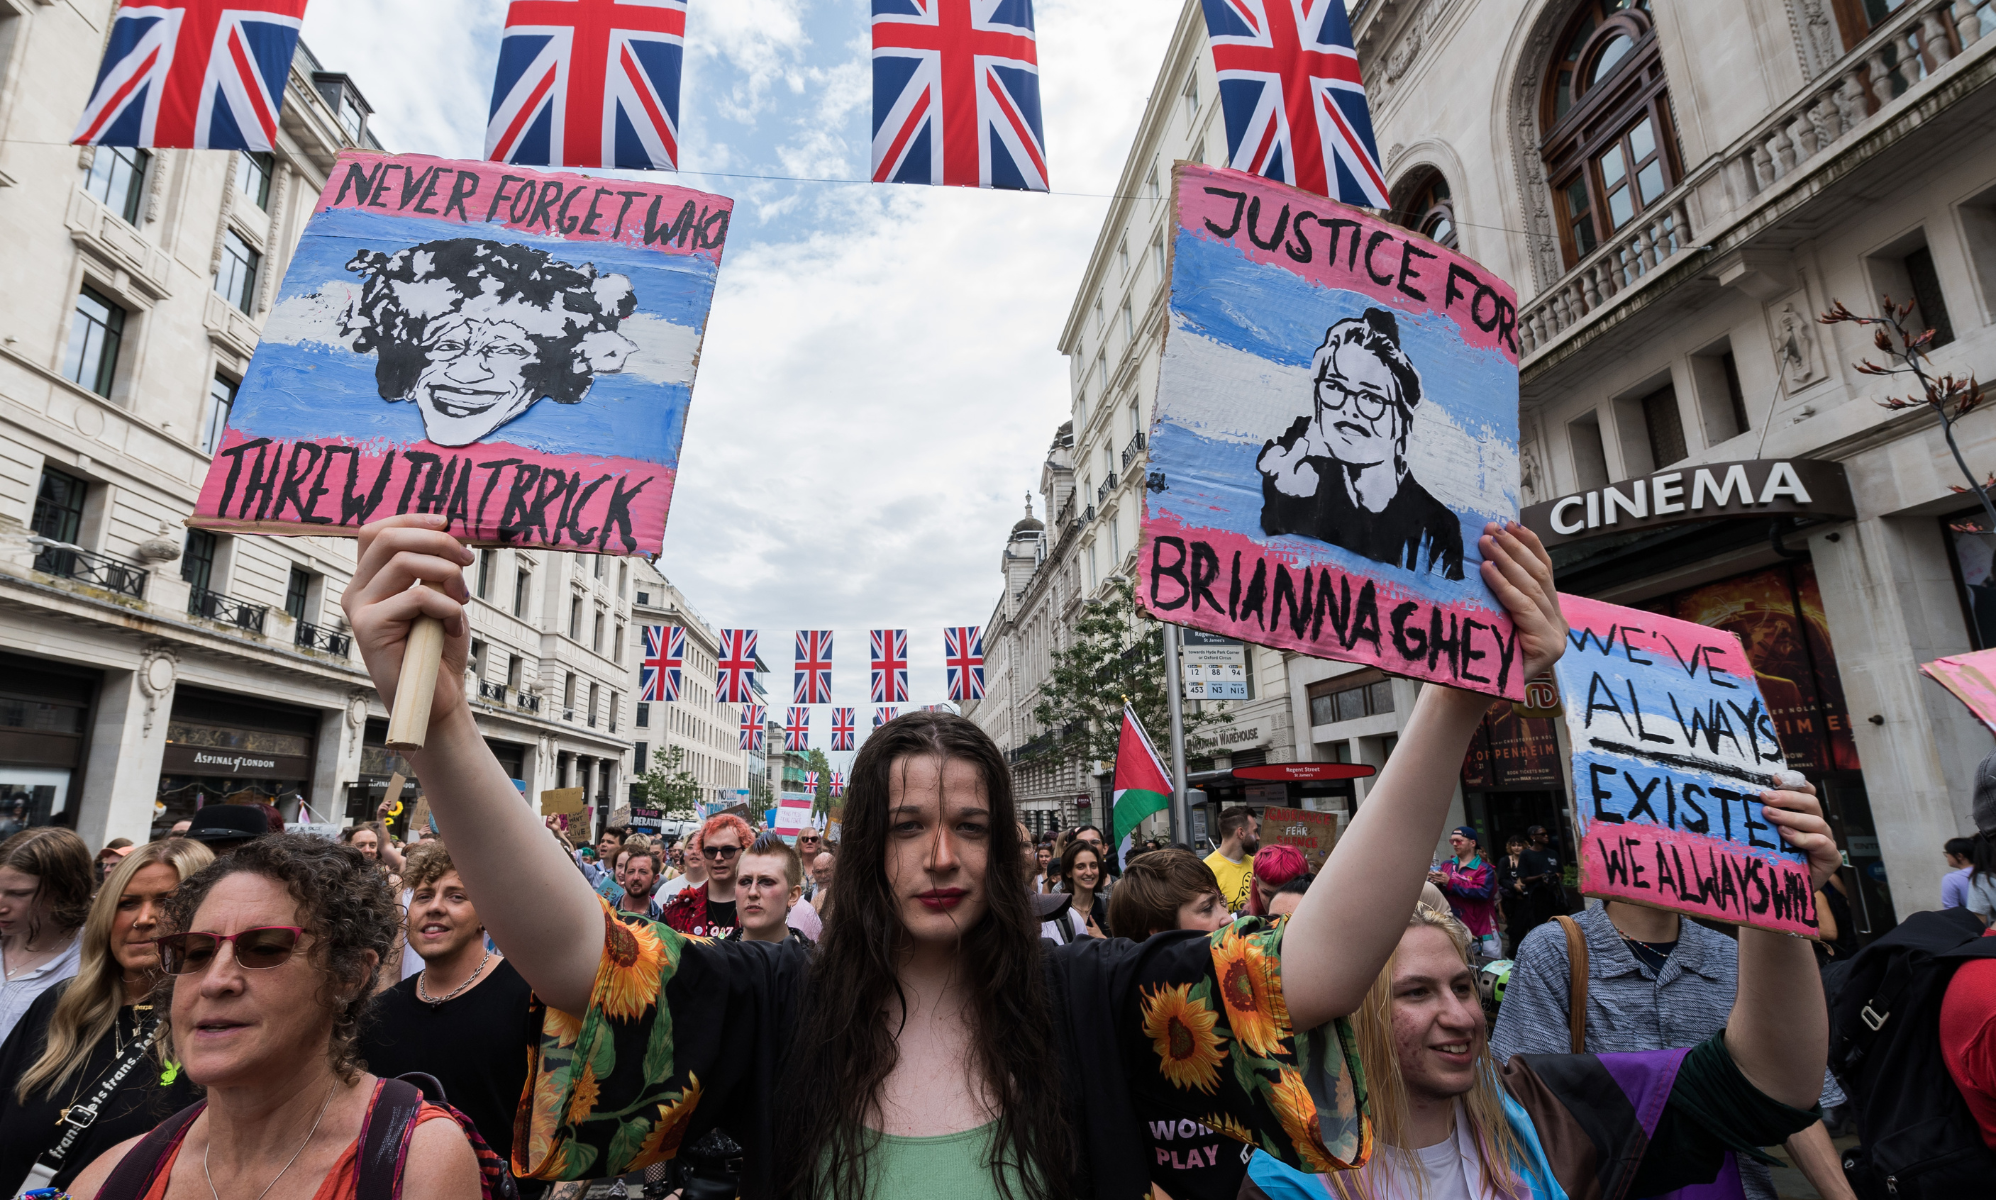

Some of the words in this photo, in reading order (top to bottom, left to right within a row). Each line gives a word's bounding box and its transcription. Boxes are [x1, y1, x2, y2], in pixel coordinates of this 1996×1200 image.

[333, 162, 480, 223] NEVER
[485, 174, 648, 239] FORGET
[643, 194, 730, 250] WHO
[1203, 186, 1438, 303] JUSTICE
[1446, 262, 1517, 354] FOR
[218, 437, 396, 526] THREW
[396, 449, 522, 540] THAT
[496, 464, 655, 554] BRICK
[1549, 462, 1813, 536] CINEMA
[1150, 535, 1383, 658] BRIANNA
[1389, 600, 1517, 694] GHEY
[1568, 623, 1740, 689] WE'VE
[1585, 671, 1785, 766] ALWAYS
[1219, 728, 1259, 745] WAREHOUSE
[194, 752, 233, 765] ASPINAL
[233, 756, 243, 772] of
[242, 758, 275, 768] LONDON
[718, 789, 726, 800] NO
[1589, 762, 1808, 854] EXISTE
[569, 815, 583, 823] WANT
[636, 808, 658, 817] TRANS
[1265, 807, 1331, 825] IGNORANCE
[570, 828, 586, 837] LIVE
[1277, 835, 1318, 848] SILENCE
[1286, 826, 1308, 836] FEAR
[1597, 835, 1650, 888] WE
[1655, 841, 1769, 920] ALWAYS
[1154, 1143, 1219, 1170] PLAY
